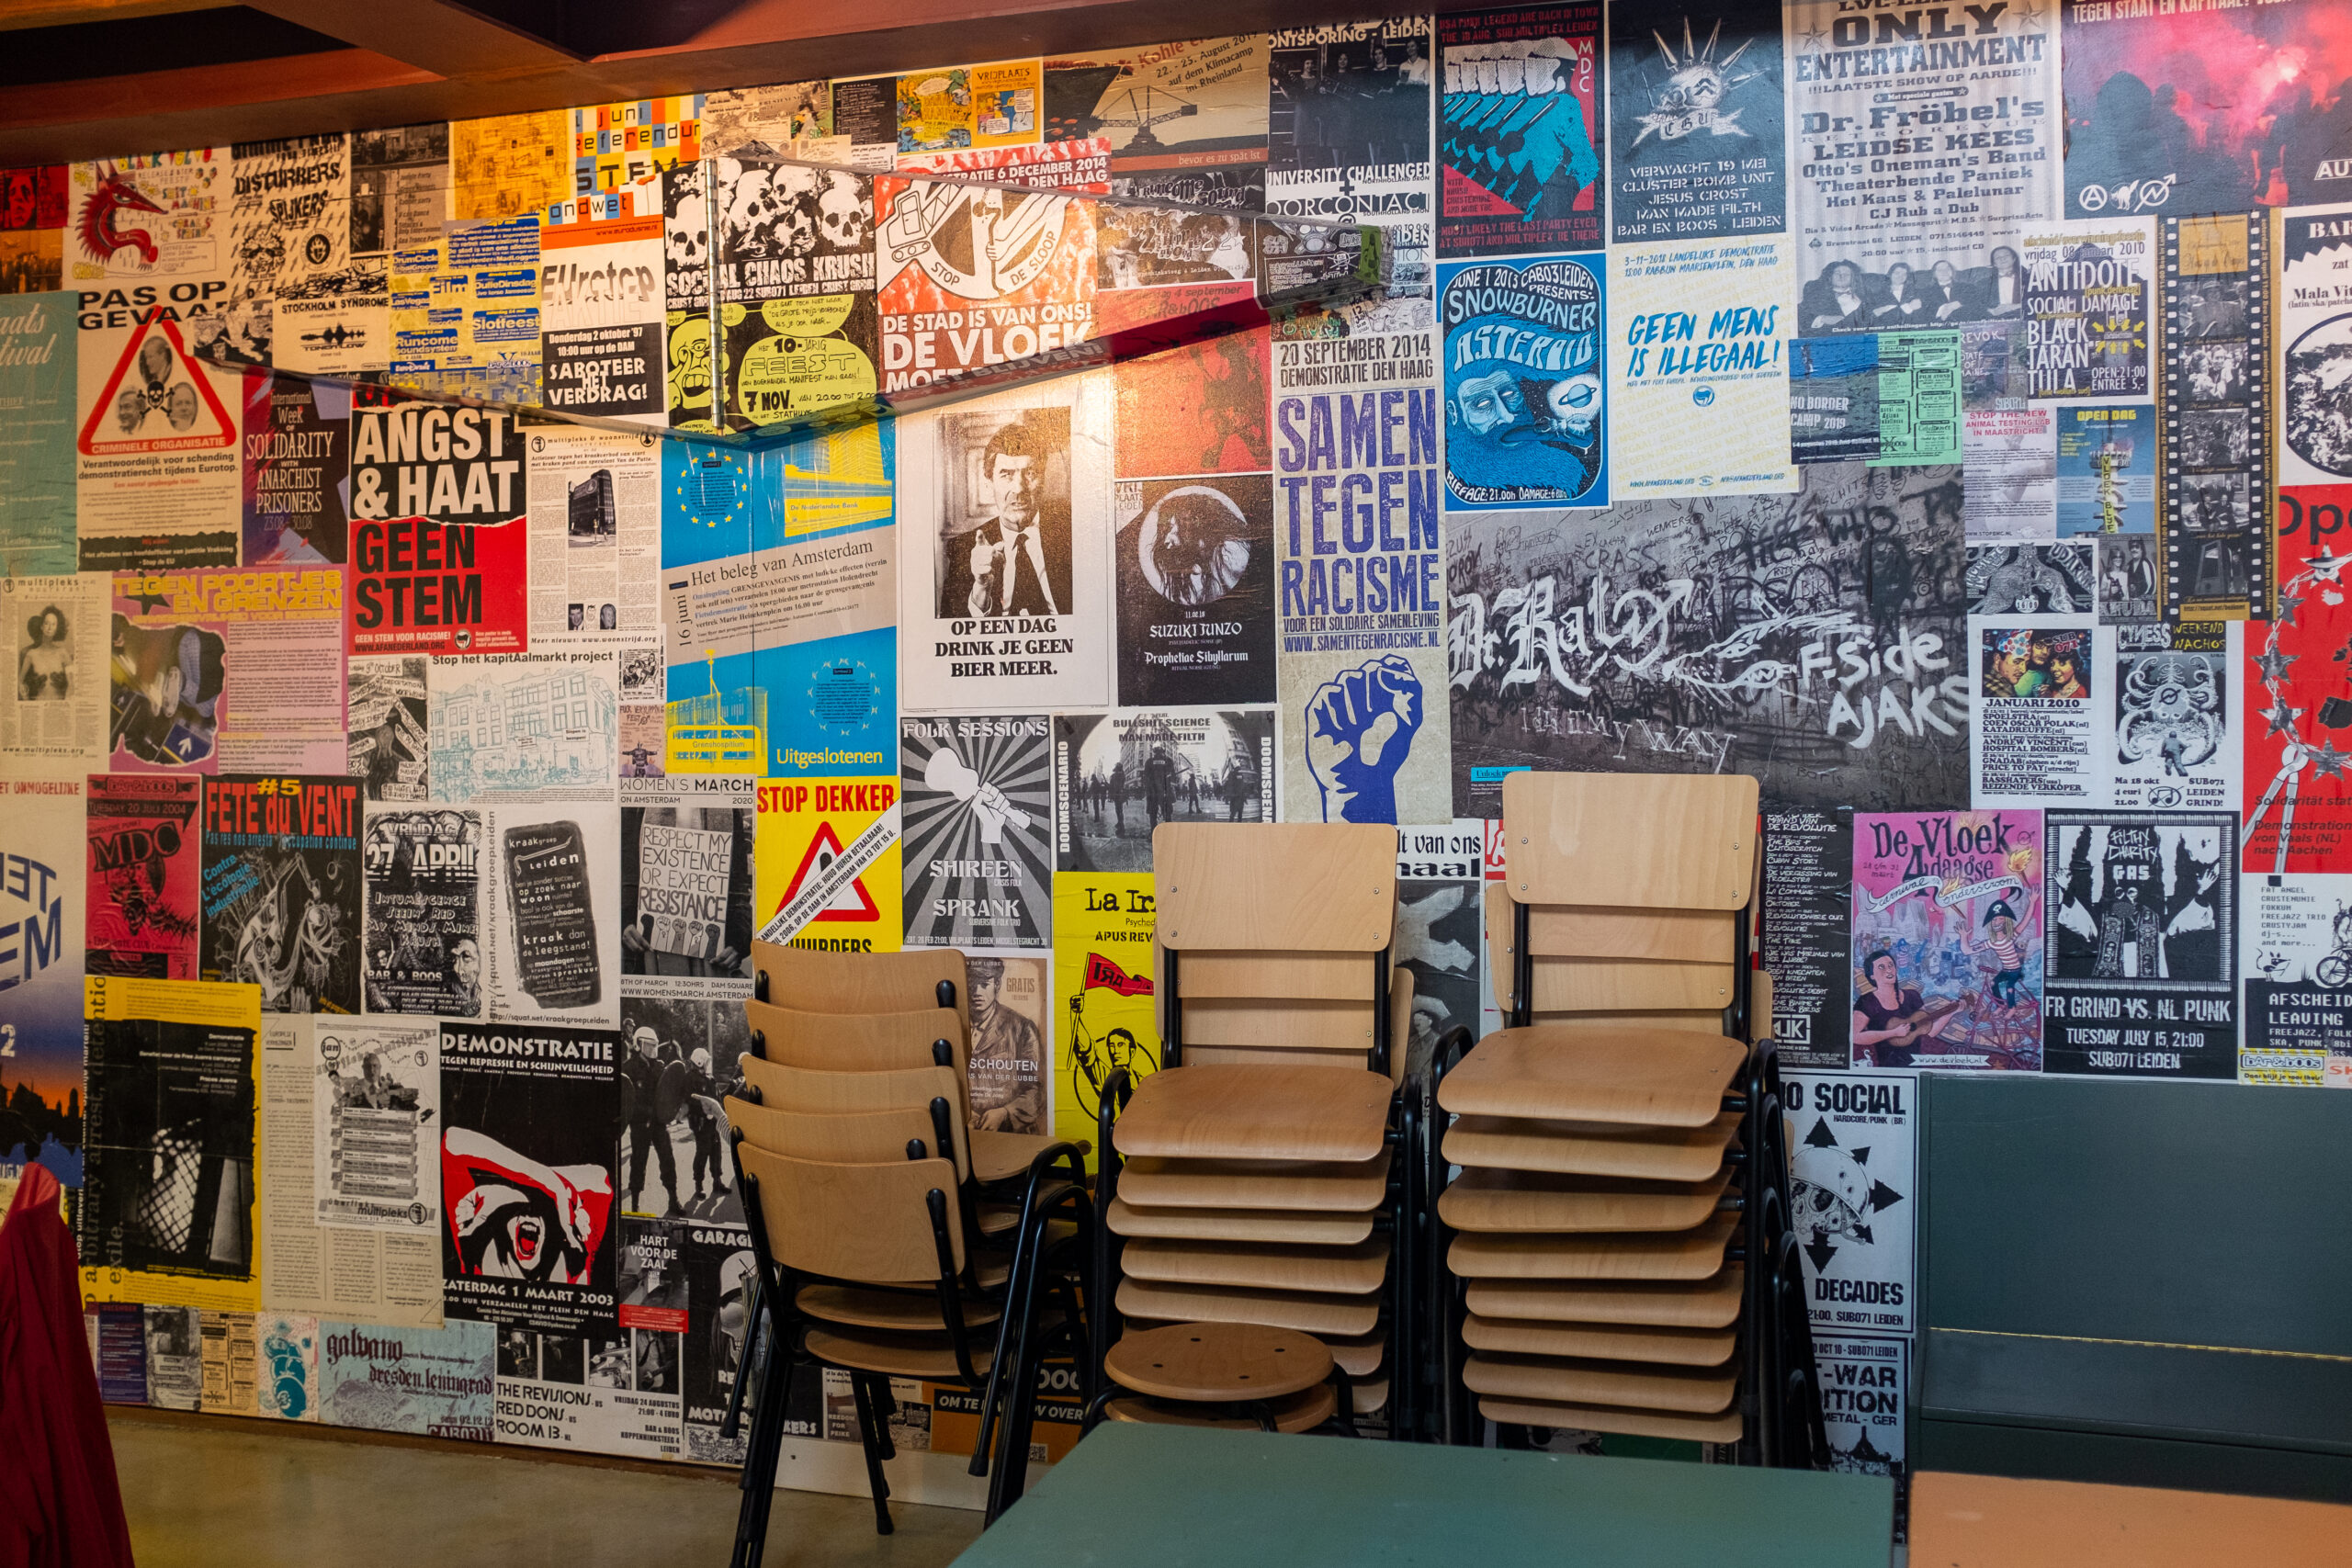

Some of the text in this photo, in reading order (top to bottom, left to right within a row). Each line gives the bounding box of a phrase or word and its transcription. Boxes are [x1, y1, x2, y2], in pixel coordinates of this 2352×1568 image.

[2073, 0, 2154, 23] TEGEN STAAT
[1269, 23, 1431, 48] ONTSPORING LEIDEN
[1833, 3, 2007, 47] ONLY
[1137, 41, 1184, 68] Kohle
[1796, 33, 2047, 82] ENTERTAINMENT
[1802, 97, 2044, 134] Dr. Fröbel's
[1814, 128, 2035, 160] LEIDSE KEES
[998, 157, 1106, 178] 6 DECEMBER 2014
[1178, 154, 1201, 164] bevor
[1230, 152, 1248, 164] spät
[1250, 151, 1261, 160] ist
[1630, 158, 1767, 178] VERWACHT 19 MEI
[234, 161, 341, 195] DISTURBERS
[1267, 163, 1431, 186] UNIVERSITY CHALLENGED
[1623, 172, 1775, 194] CLUSTER BOMB UNIT
[1648, 188, 1748, 206] JESUS CROST
[1636, 201, 1761, 220] MAN MADE FILTH
[1617, 215, 1781, 236] BAR EN BOOS LEIDEN
[744, 257, 807, 285] CHAOS
[812, 253, 876, 278] KRUSH
[1453, 268, 1481, 289] JUNE
[1494, 265, 1519, 288] 2013
[2027, 259, 2140, 292] ANTIDOTE
[78, 281, 227, 310] PAS OP
[281, 293, 390, 314] STOCKHOLM SYNDROME
[883, 302, 1091, 333] DE STAD IS VAN ONS!
[1448, 288, 1597, 332] SNOWBURNER
[472, 318, 541, 331] Slotfeest
[1628, 305, 1780, 346] GEEN MENS
[2027, 318, 2088, 345] BLACK
[1280, 333, 1431, 367] 20 SEPTEMBER 2014
[1454, 323, 1594, 373] ASTEROID
[1627, 340, 1780, 378] IS ILLEGAAL!
[2027, 345, 2088, 370] TARAN
[1280, 359, 1433, 388] DEMONSTRATIE DEN HAAG
[354, 407, 513, 464] ANGST
[1279, 388, 1437, 472] SAMEN
[92, 436, 226, 454] CRIMINELE ORGANISATIE
[246, 431, 334, 460] SOLIDARITY
[257, 469, 322, 491] ANARCHIST
[354, 460, 519, 517] & HAAT
[256, 492, 322, 513] PRISONERS
[1280, 468, 1439, 557] TEGEN
[356, 523, 475, 574] GEEN
[691, 540, 874, 586] Het beleg van Amsterdam
[1281, 554, 1440, 616] RACISME
[356, 573, 481, 628] STEM
[951, 618, 1057, 635] OP EEN DAG
[1283, 613, 1440, 632] VOOR EEN SOLIDAIRE SAMENLEVING
[355, 631, 451, 643] GEEN STEM VOOR RACISME!
[935, 638, 1073, 657] DRINK JE GEEN
[433, 654, 458, 665] Stop
[461, 653, 481, 663] het
[571, 650, 613, 663] project
[951, 660, 1057, 677] BIER MEER.
[1986, 698, 2080, 708] JANUARI 2010
[903, 721, 1048, 739] FOLK SESSIONS
[776, 747, 883, 769] Uitgeslotenen
[620, 777, 752, 791] WOMEN'S MARCH
[1059, 740, 1069, 852] DOOMSCENARIO
[206, 782, 259, 834] FETE
[299, 784, 356, 837] VENT
[757, 784, 894, 814] STOP DEKKER
[643, 827, 732, 852] RESPECT MY
[1870, 815, 2015, 859] De Vloek
[642, 847, 729, 874] EXISTENCE
[930, 860, 1023, 878] SHIREEN
[639, 886, 727, 923] RESISTANCE
[933, 899, 1020, 918] SPRANK
[1007, 977, 1035, 993] GRATIS
[2045, 996, 2065, 1017] FR
[2071, 998, 2120, 1019] GRIND
[2158, 1000, 2179, 1020] NL
[2184, 1000, 2231, 1021] PUNK
[441, 1033, 614, 1061] DEMONSTRATIE
[2066, 1029, 2120, 1044] TUESDAY
[2123, 1029, 2152, 1045] JULY
[2172, 1032, 2204, 1047] 21:00
[441, 1055, 614, 1075] TEGEN REPRESSIE EN SCHIJNVEILIGHEID
[969, 1059, 1038, 1072] SCHOUTEN
[2089, 1053, 2181, 1069] SUB071 LEIDEN
[1815, 1083, 1906, 1115] SOCIAL
[630, 1245, 677, 1259] VOOR DE
[640, 1234, 669, 1247] HART
[640, 1258, 667, 1270] ZAAL
[443, 1279, 614, 1305] ZATERDAG 1 MAART 2003
[1815, 1278, 1905, 1306] DECADES
[1837, 1312, 1904, 1325] SUB071 LEIDEN
[496, 1382, 520, 1397] THE
[496, 1401, 523, 1416] RED
[496, 1420, 545, 1438] ROOM
